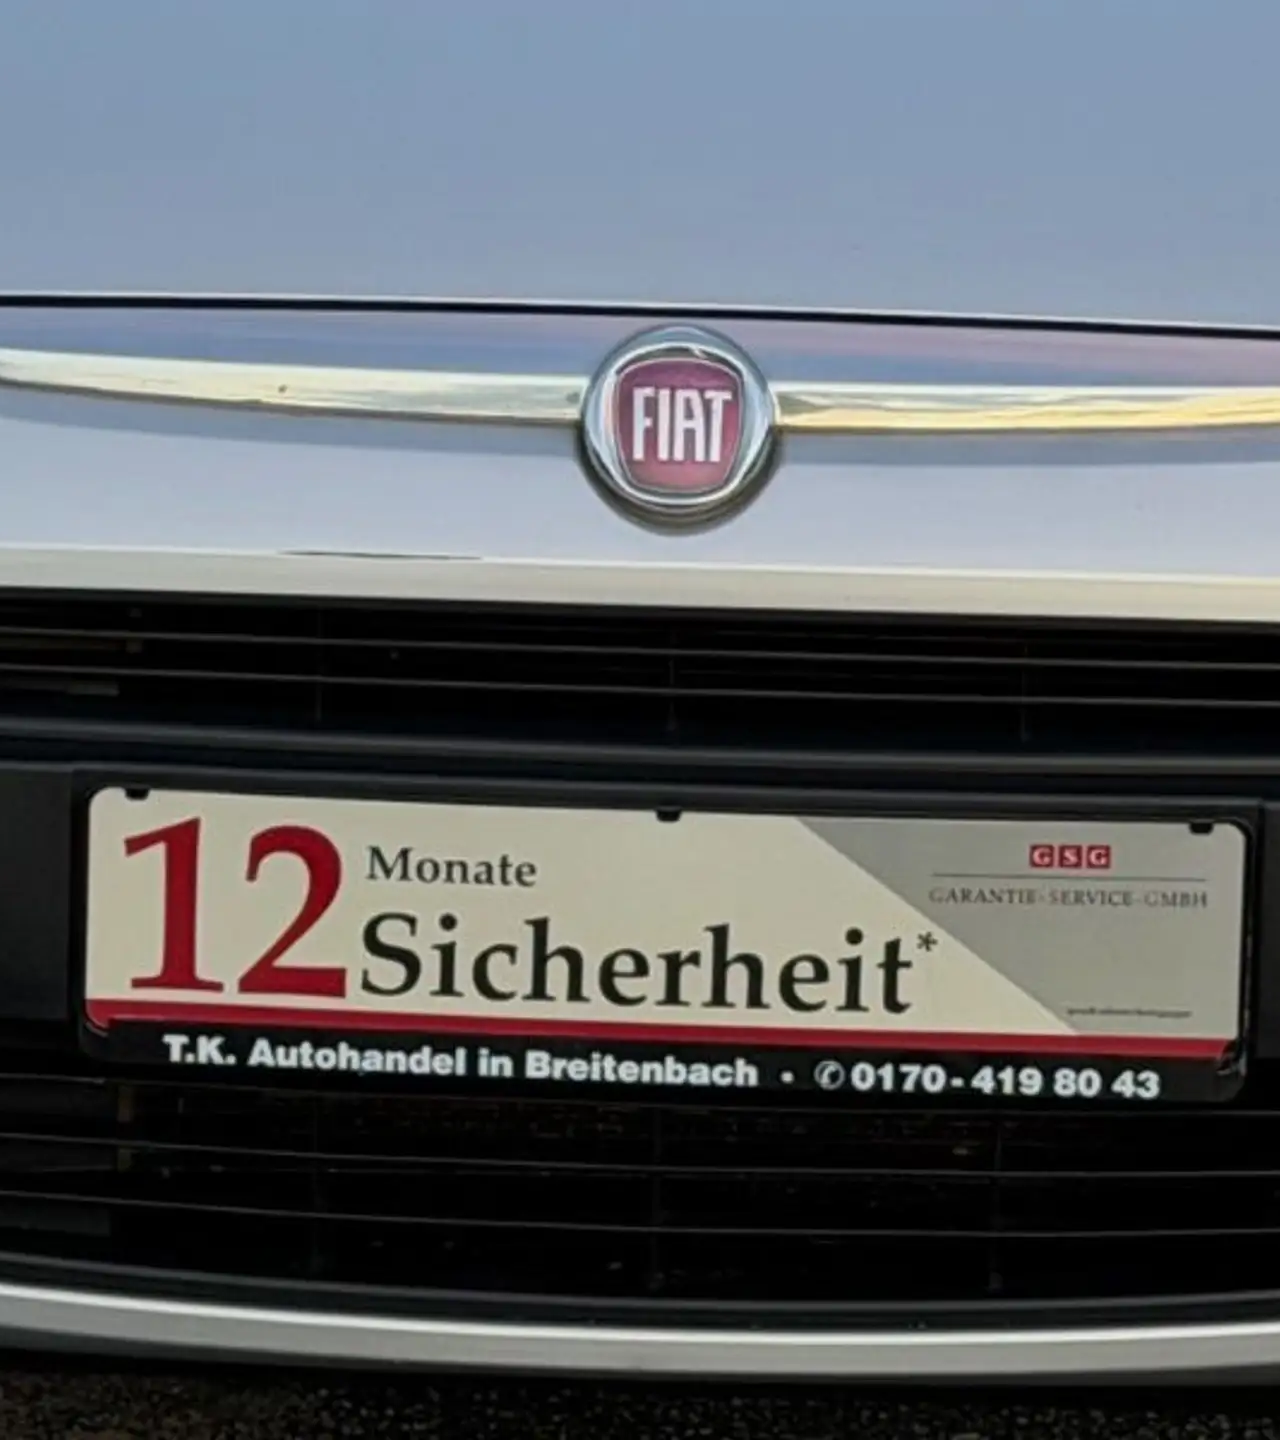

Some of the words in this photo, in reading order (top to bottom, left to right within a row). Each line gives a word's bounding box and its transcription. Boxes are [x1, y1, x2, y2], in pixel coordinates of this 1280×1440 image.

[632, 385, 733, 463] FIAT
[365, 845, 537, 887] Monate
[1030, 846, 1111, 868] GSG
[124, 816, 347, 998] 12
[163, 1034, 236, 1065] T.K.
[248, 1037, 467, 1077] Autohandel
[478, 1048, 513, 1078] in
[525, 1050, 758, 1088] Breitenbach
[1053, 1067, 1100, 1097] 80
[1111, 1068, 1161, 1099] 43
